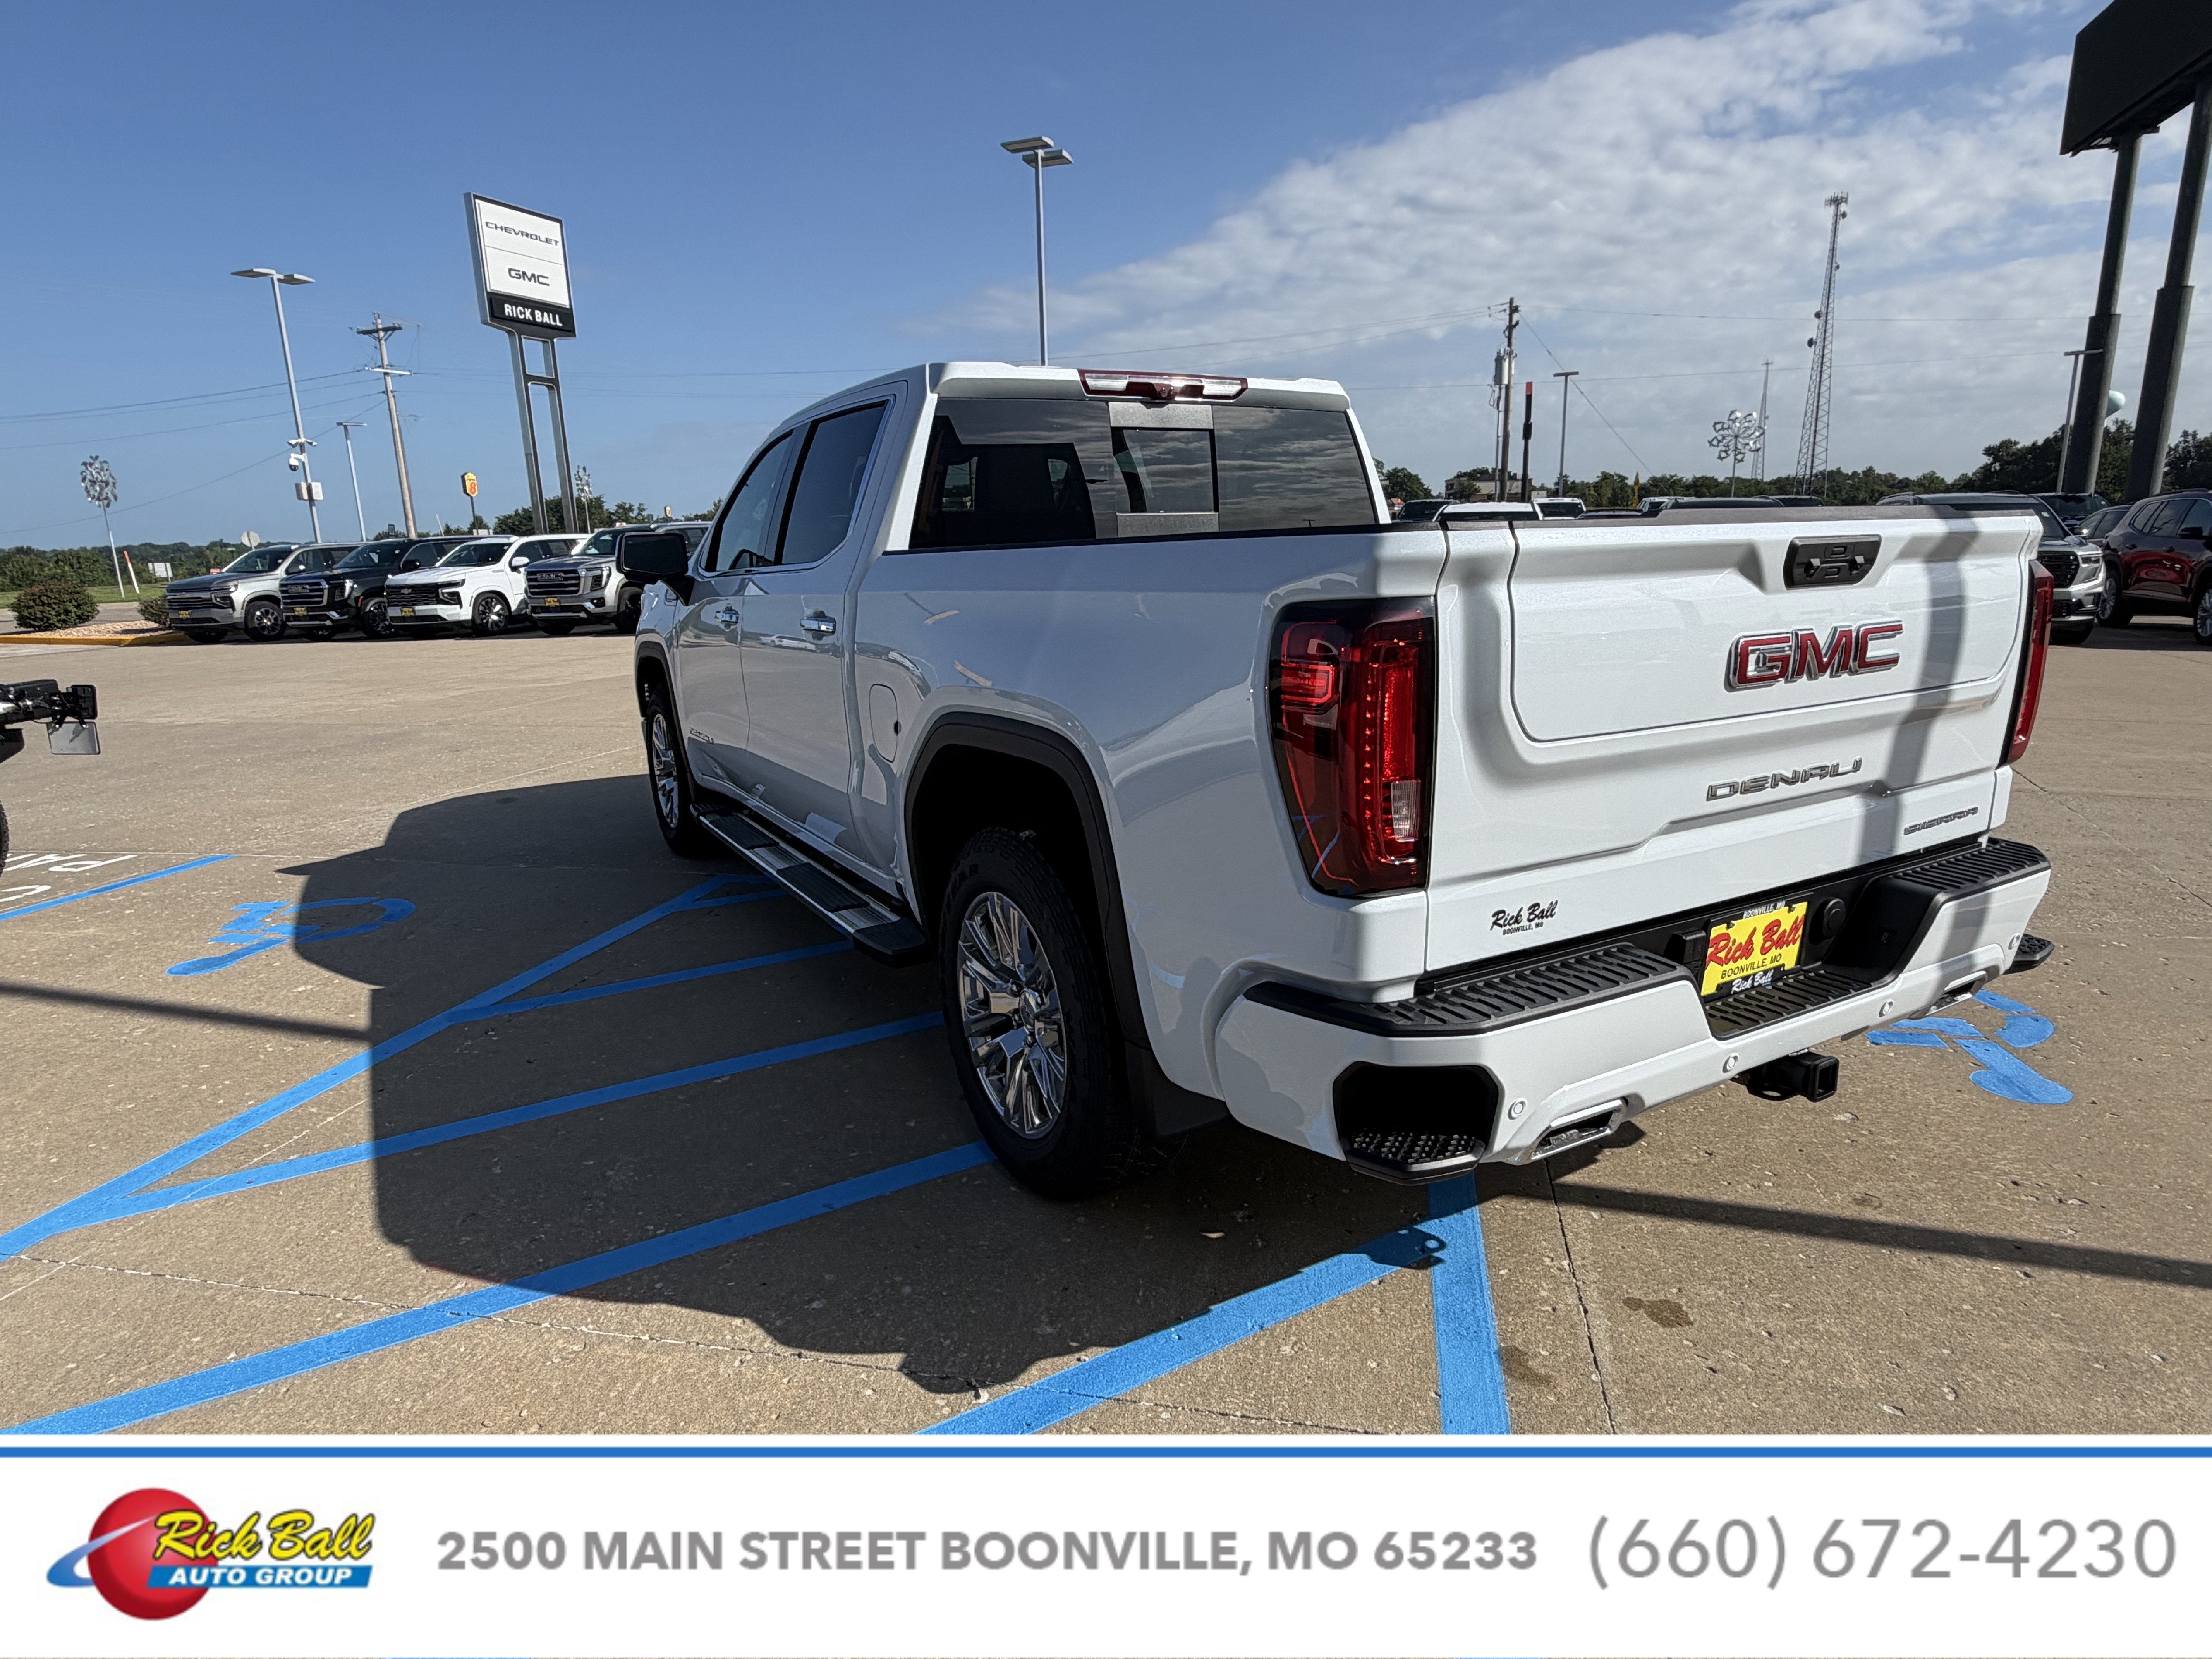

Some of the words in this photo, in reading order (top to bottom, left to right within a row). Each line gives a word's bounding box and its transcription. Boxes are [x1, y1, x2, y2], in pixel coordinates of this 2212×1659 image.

[485, 221, 559, 246] CHEVROLET
[508, 267, 550, 287] GMC
[504, 303, 532, 321] RICK
[535, 310, 563, 326] BALL
[470, 482, 476, 494] 8
[1726, 620, 1903, 691] GMC
[1706, 757, 1862, 802] DENALI
[1903, 806, 1978, 836] SIERRA
[1489, 906, 1523, 931] Rick
[1527, 900, 1558, 923] Ball
[1705, 926, 1757, 969] Rick
[1760, 914, 1805, 956] Ball
[1770, 953, 1782, 964] MO
[1731, 975, 1753, 994] Rick
[1754, 969, 1774, 986] Ball
